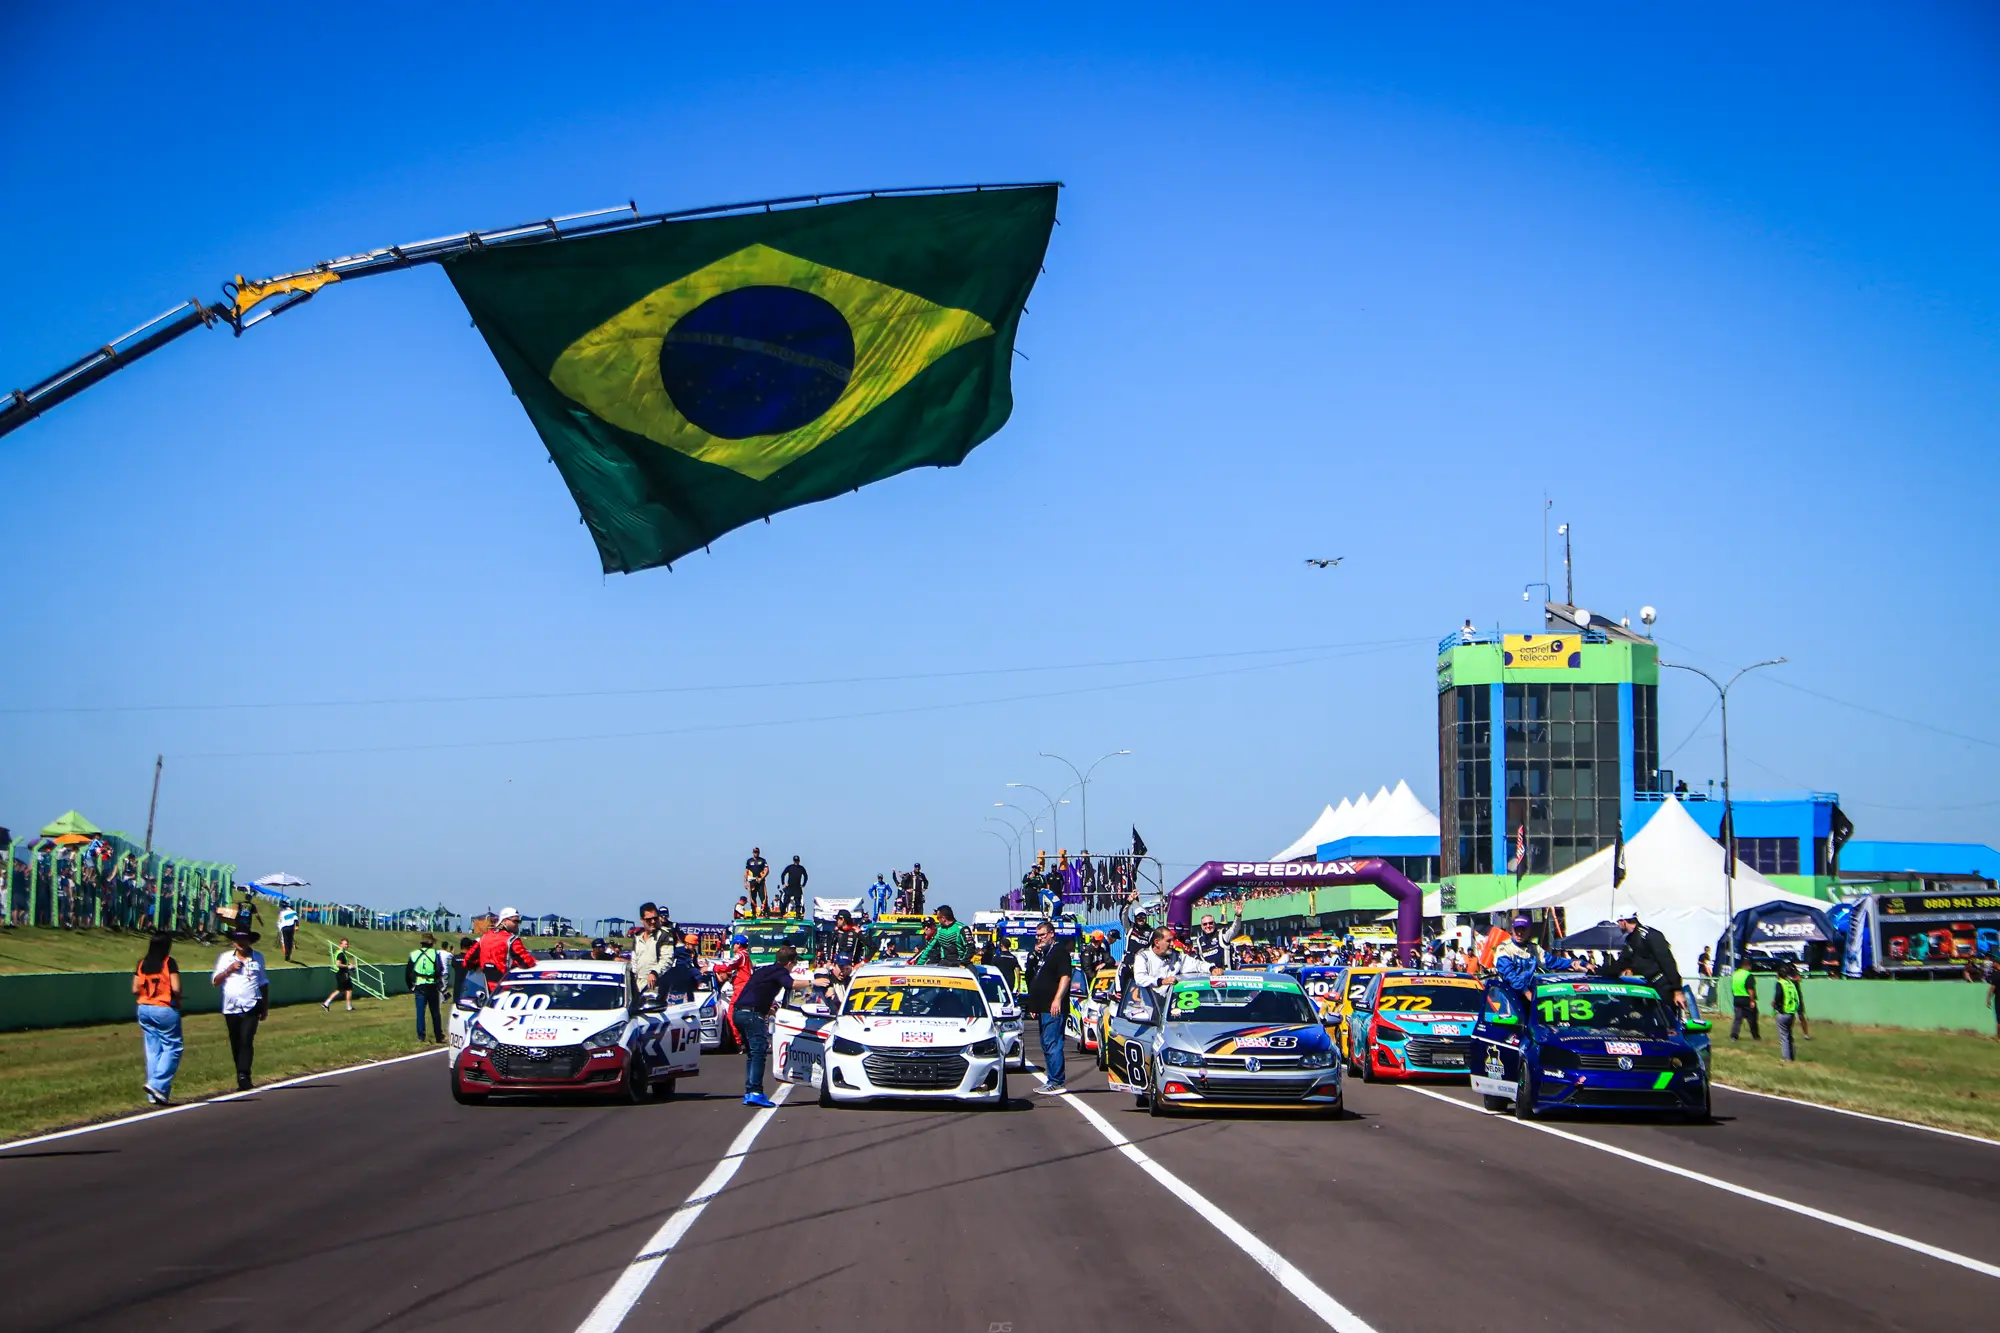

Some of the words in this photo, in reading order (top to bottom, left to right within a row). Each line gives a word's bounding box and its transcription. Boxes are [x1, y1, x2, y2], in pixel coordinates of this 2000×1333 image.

[1222, 861, 1357, 876] SPEEDMAX
[1923, 898, 1951, 909] 0800
[1952, 897, 1973, 908] 941
[679, 926, 723, 935] EEDMAX
[1773, 923, 1816, 937] MBR
[142, 978, 161, 998] 17
[491, 991, 550, 1010] 100
[849, 991, 904, 1011] 171
[1177, 991, 1201, 1010] 8
[1379, 996, 1433, 1011] 272
[1537, 1000, 1594, 1022] 113
[1270, 1036, 1298, 1048] 8
[1125, 1040, 1148, 1090] 8
